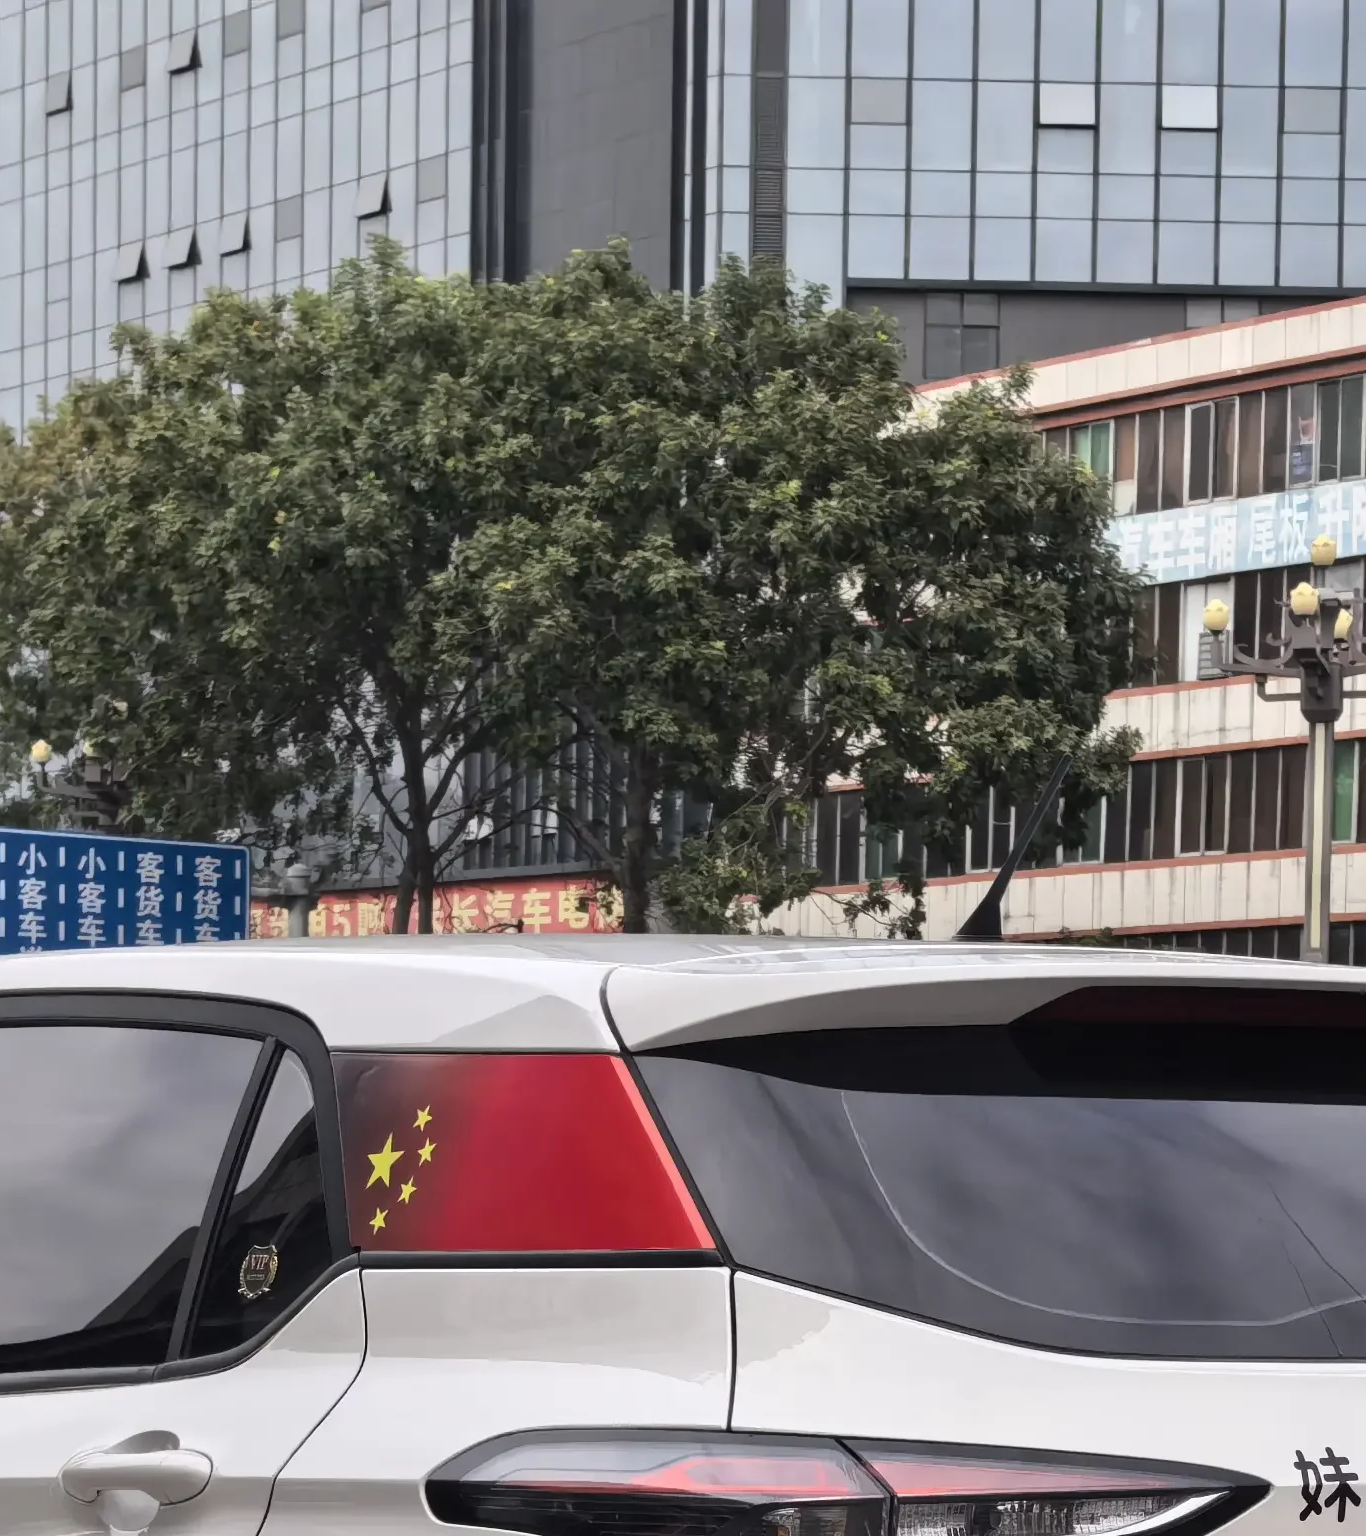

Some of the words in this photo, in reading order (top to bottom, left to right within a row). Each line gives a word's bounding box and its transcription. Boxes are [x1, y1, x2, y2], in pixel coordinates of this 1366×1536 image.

[17, 843, 47, 953] 小客车
[77, 847, 106, 947] 小客车
[136, 852, 165, 946] 客货车
